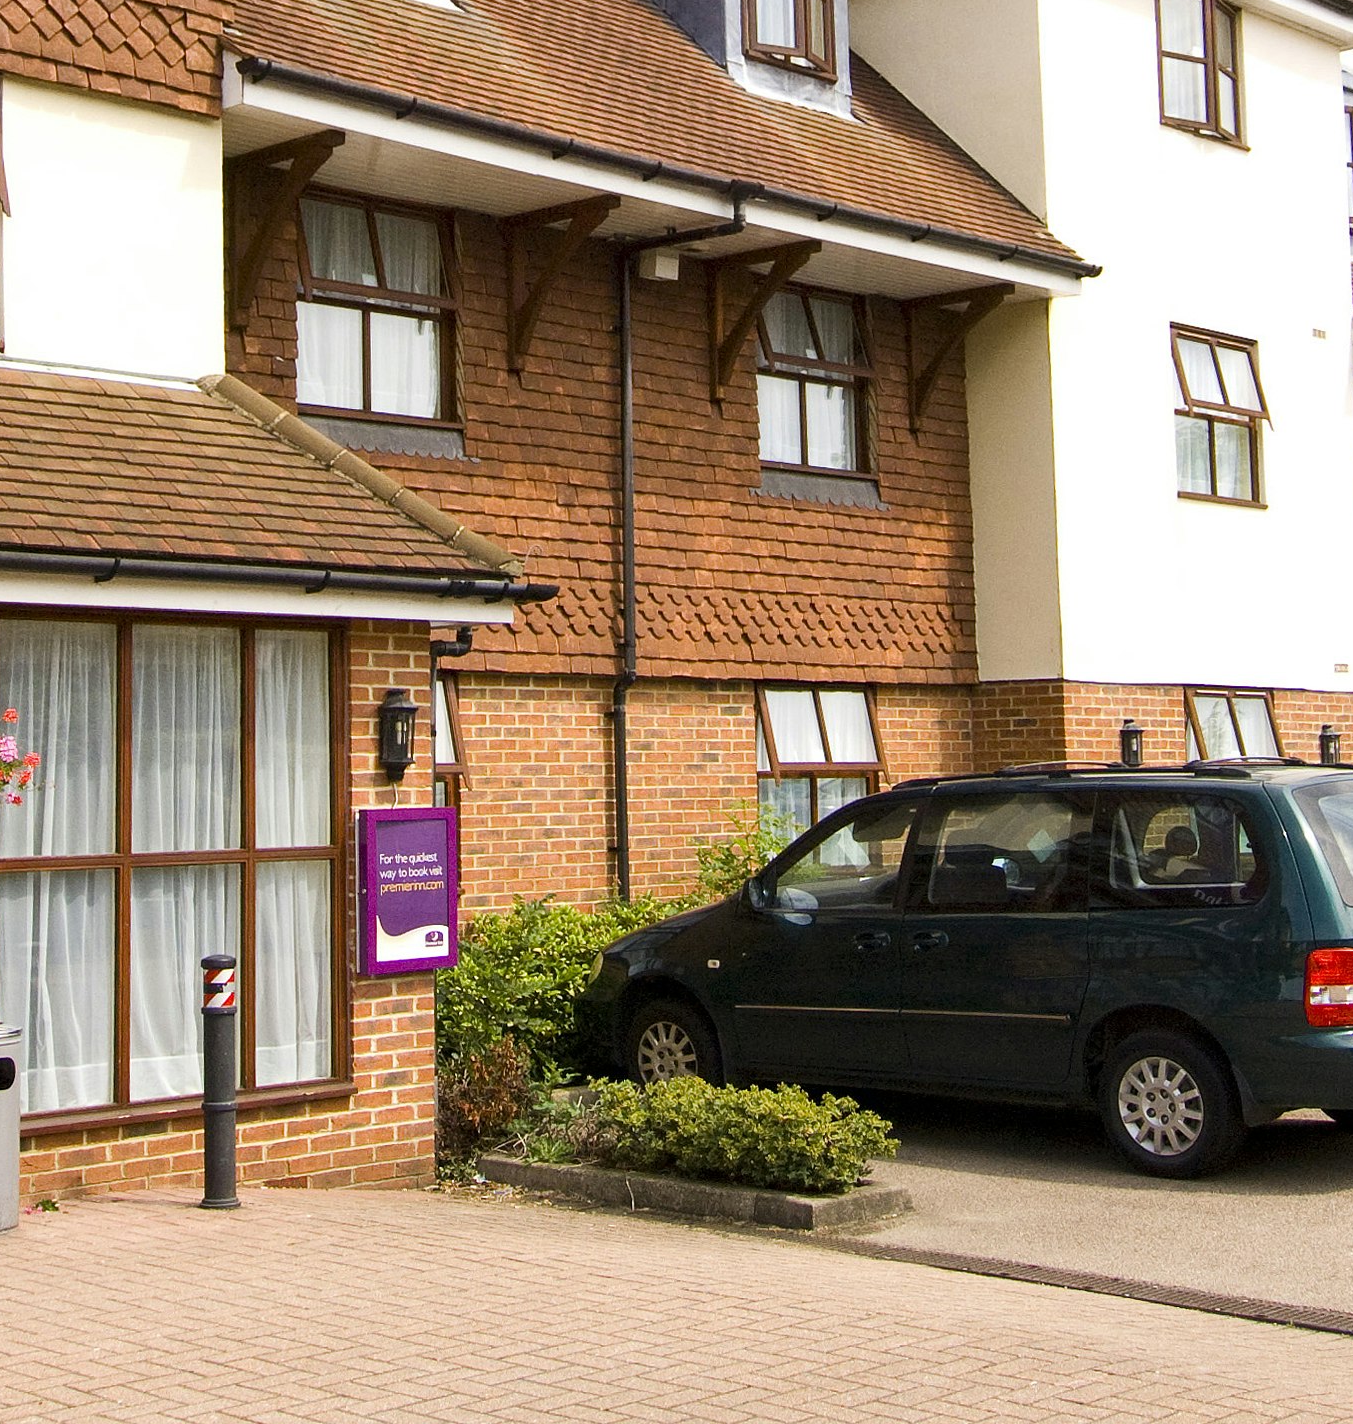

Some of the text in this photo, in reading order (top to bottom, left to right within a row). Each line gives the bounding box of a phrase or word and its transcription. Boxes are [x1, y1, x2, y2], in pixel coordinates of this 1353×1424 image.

[379, 852, 438, 866] For the quickest
[379, 865, 443, 881] way to book visit
[380, 880, 444, 896] premierinn.com
